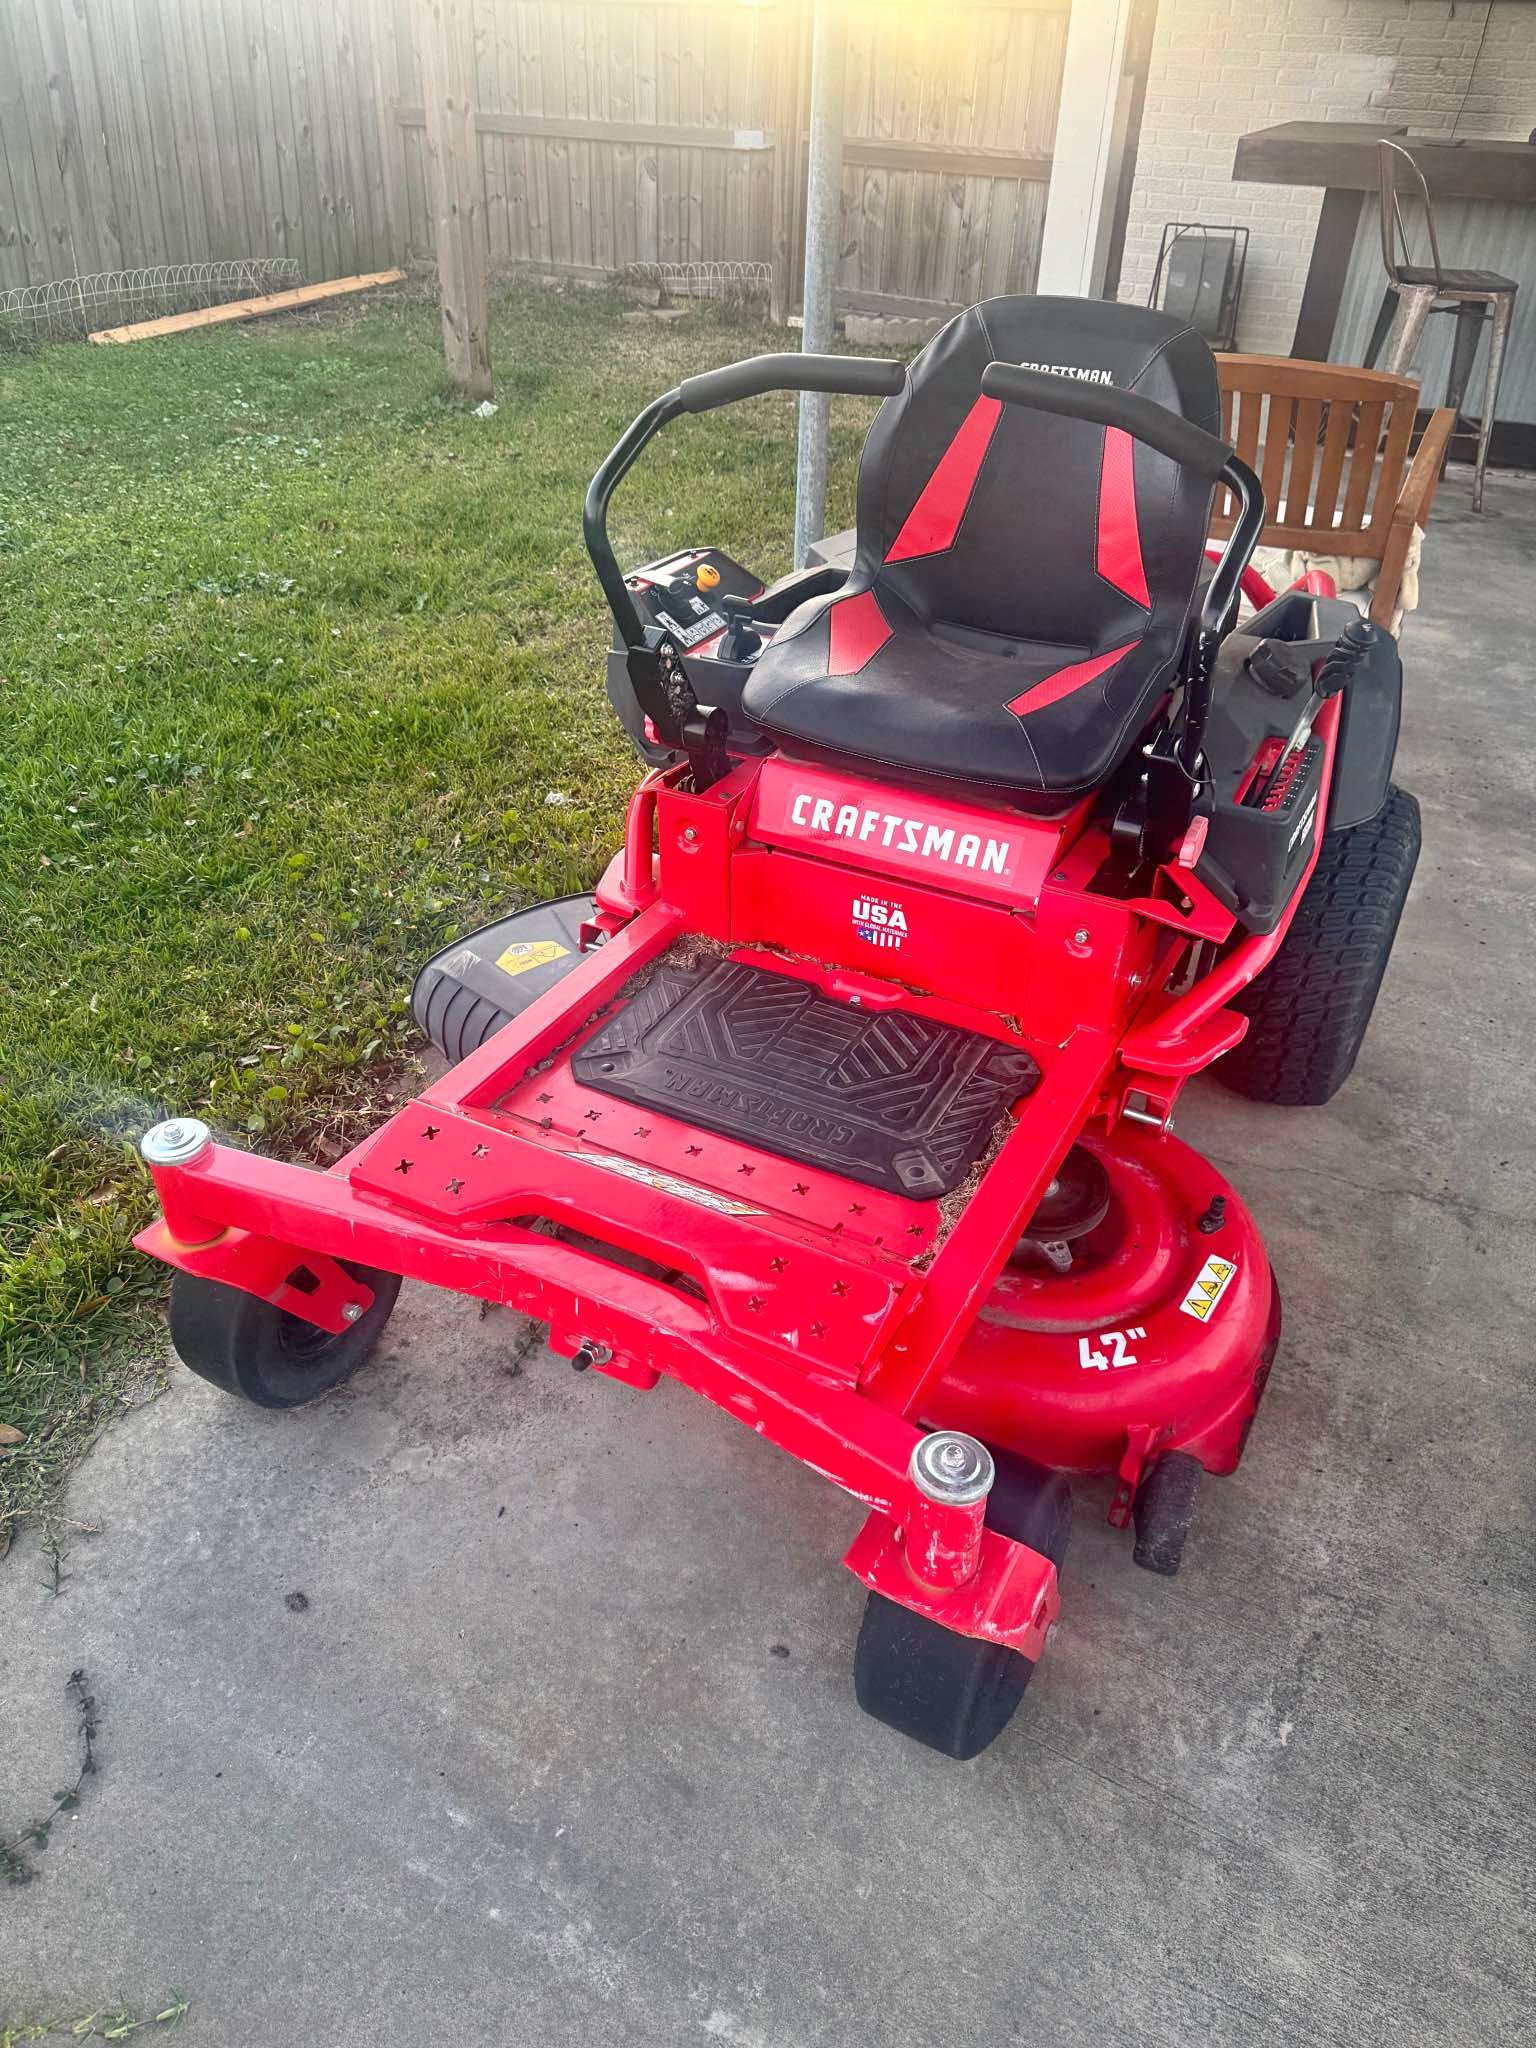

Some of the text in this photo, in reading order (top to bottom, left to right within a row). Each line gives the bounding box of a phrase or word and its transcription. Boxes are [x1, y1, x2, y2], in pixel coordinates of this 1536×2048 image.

[791, 794, 1010, 875] CRAFTSMAN
[852, 899, 908, 932] USA
[860, 894, 879, 904] MADE
[890, 901, 903, 910] THE
[664, 1070, 856, 1146] CRAFTSMAN
[1078, 1326, 1147, 1371] 42"
